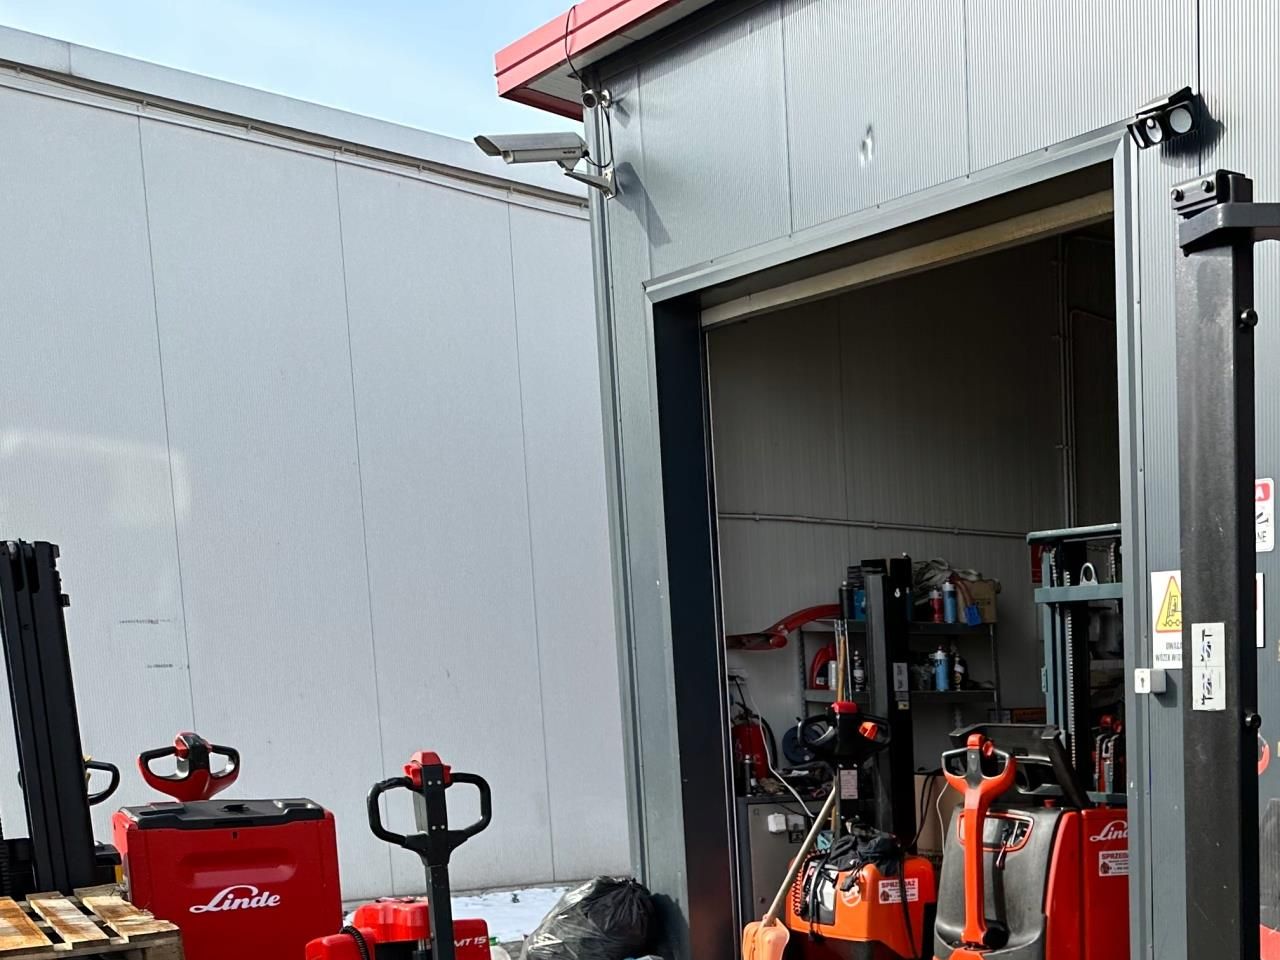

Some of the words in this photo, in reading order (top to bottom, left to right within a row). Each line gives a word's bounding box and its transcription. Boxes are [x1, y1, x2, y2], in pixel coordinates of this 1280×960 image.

[1089, 819, 1128, 841] Lin
[189, 884, 280, 913] Linde
[474, 935, 487, 945] 15
